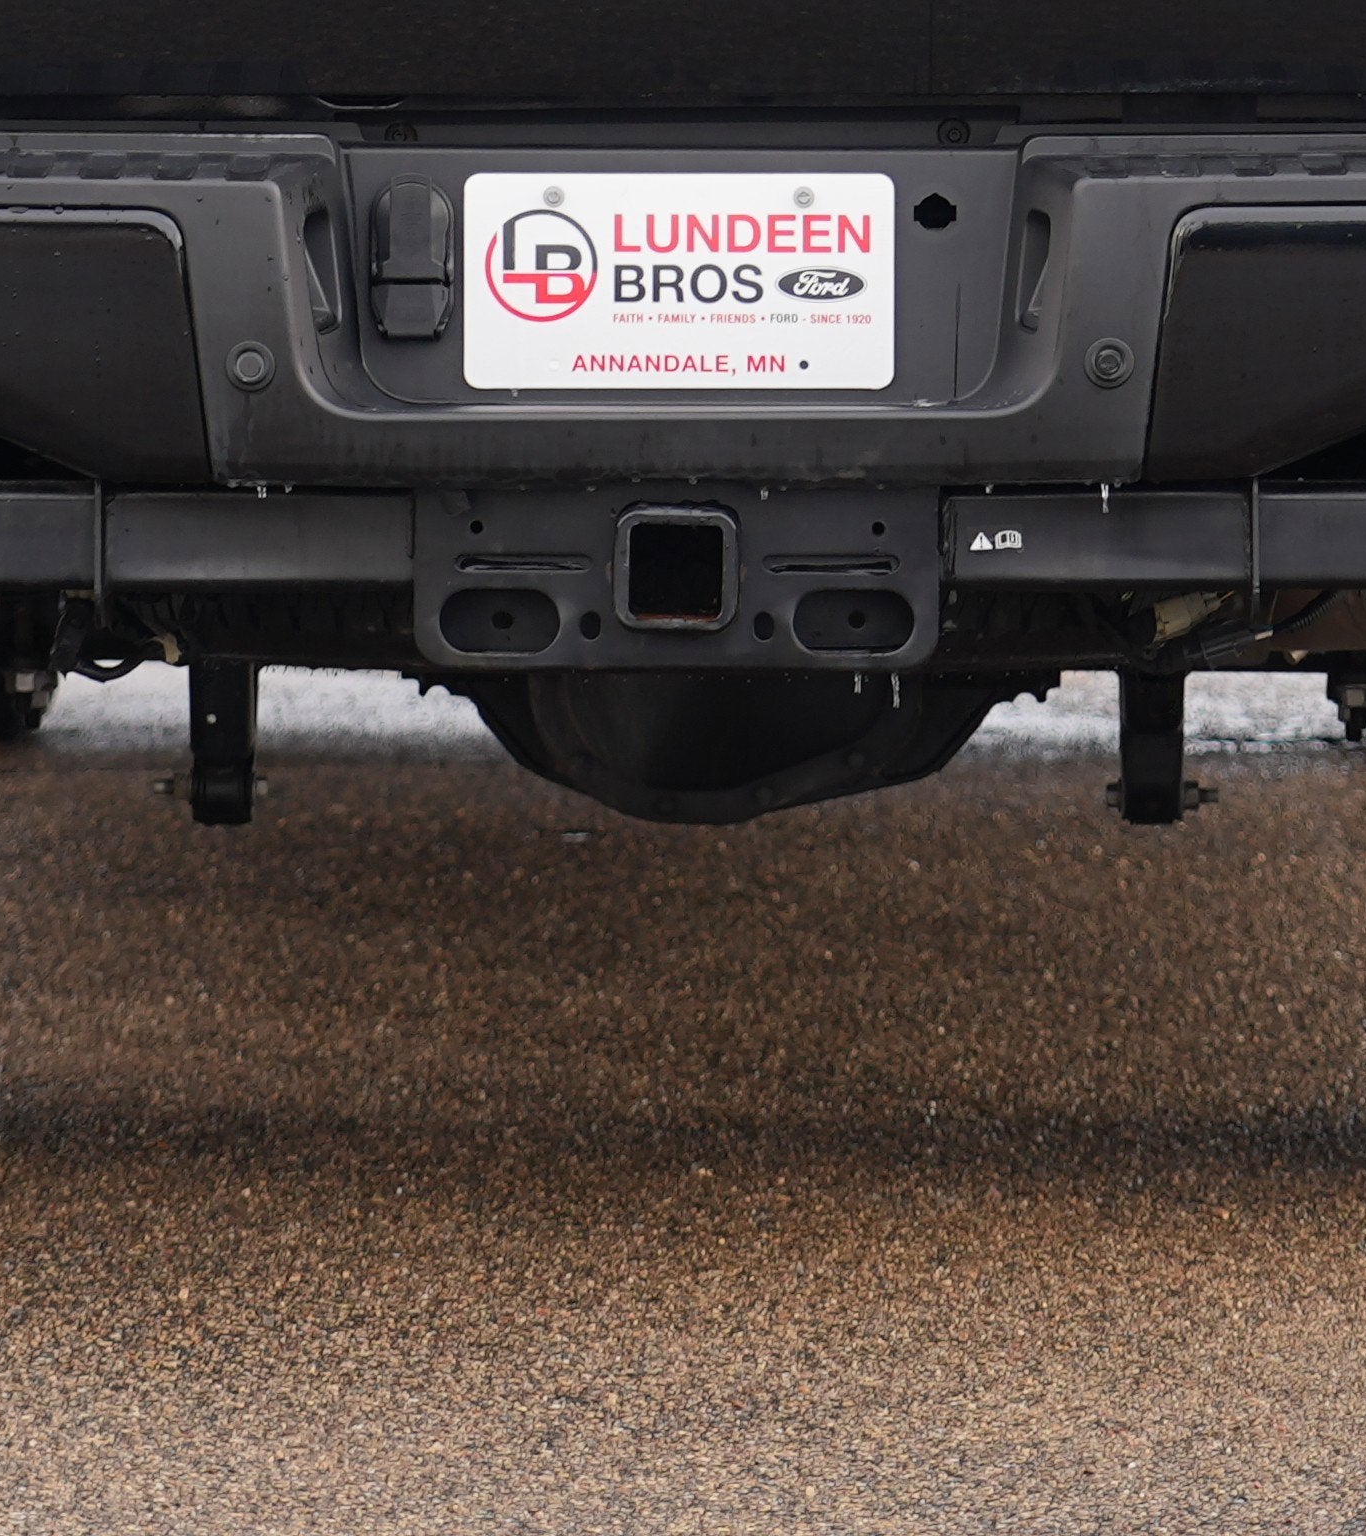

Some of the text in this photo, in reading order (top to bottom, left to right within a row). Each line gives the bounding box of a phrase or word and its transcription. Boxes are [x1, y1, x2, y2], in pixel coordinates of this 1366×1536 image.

[613, 214, 871, 253] LUNDEEN
[613, 264, 851, 303] BROS Ford
[613, 313, 872, 325] FAITH FAMILY FRIENDS FORD SINCE 1920
[571, 354, 786, 376] ANNANDALE, MN
